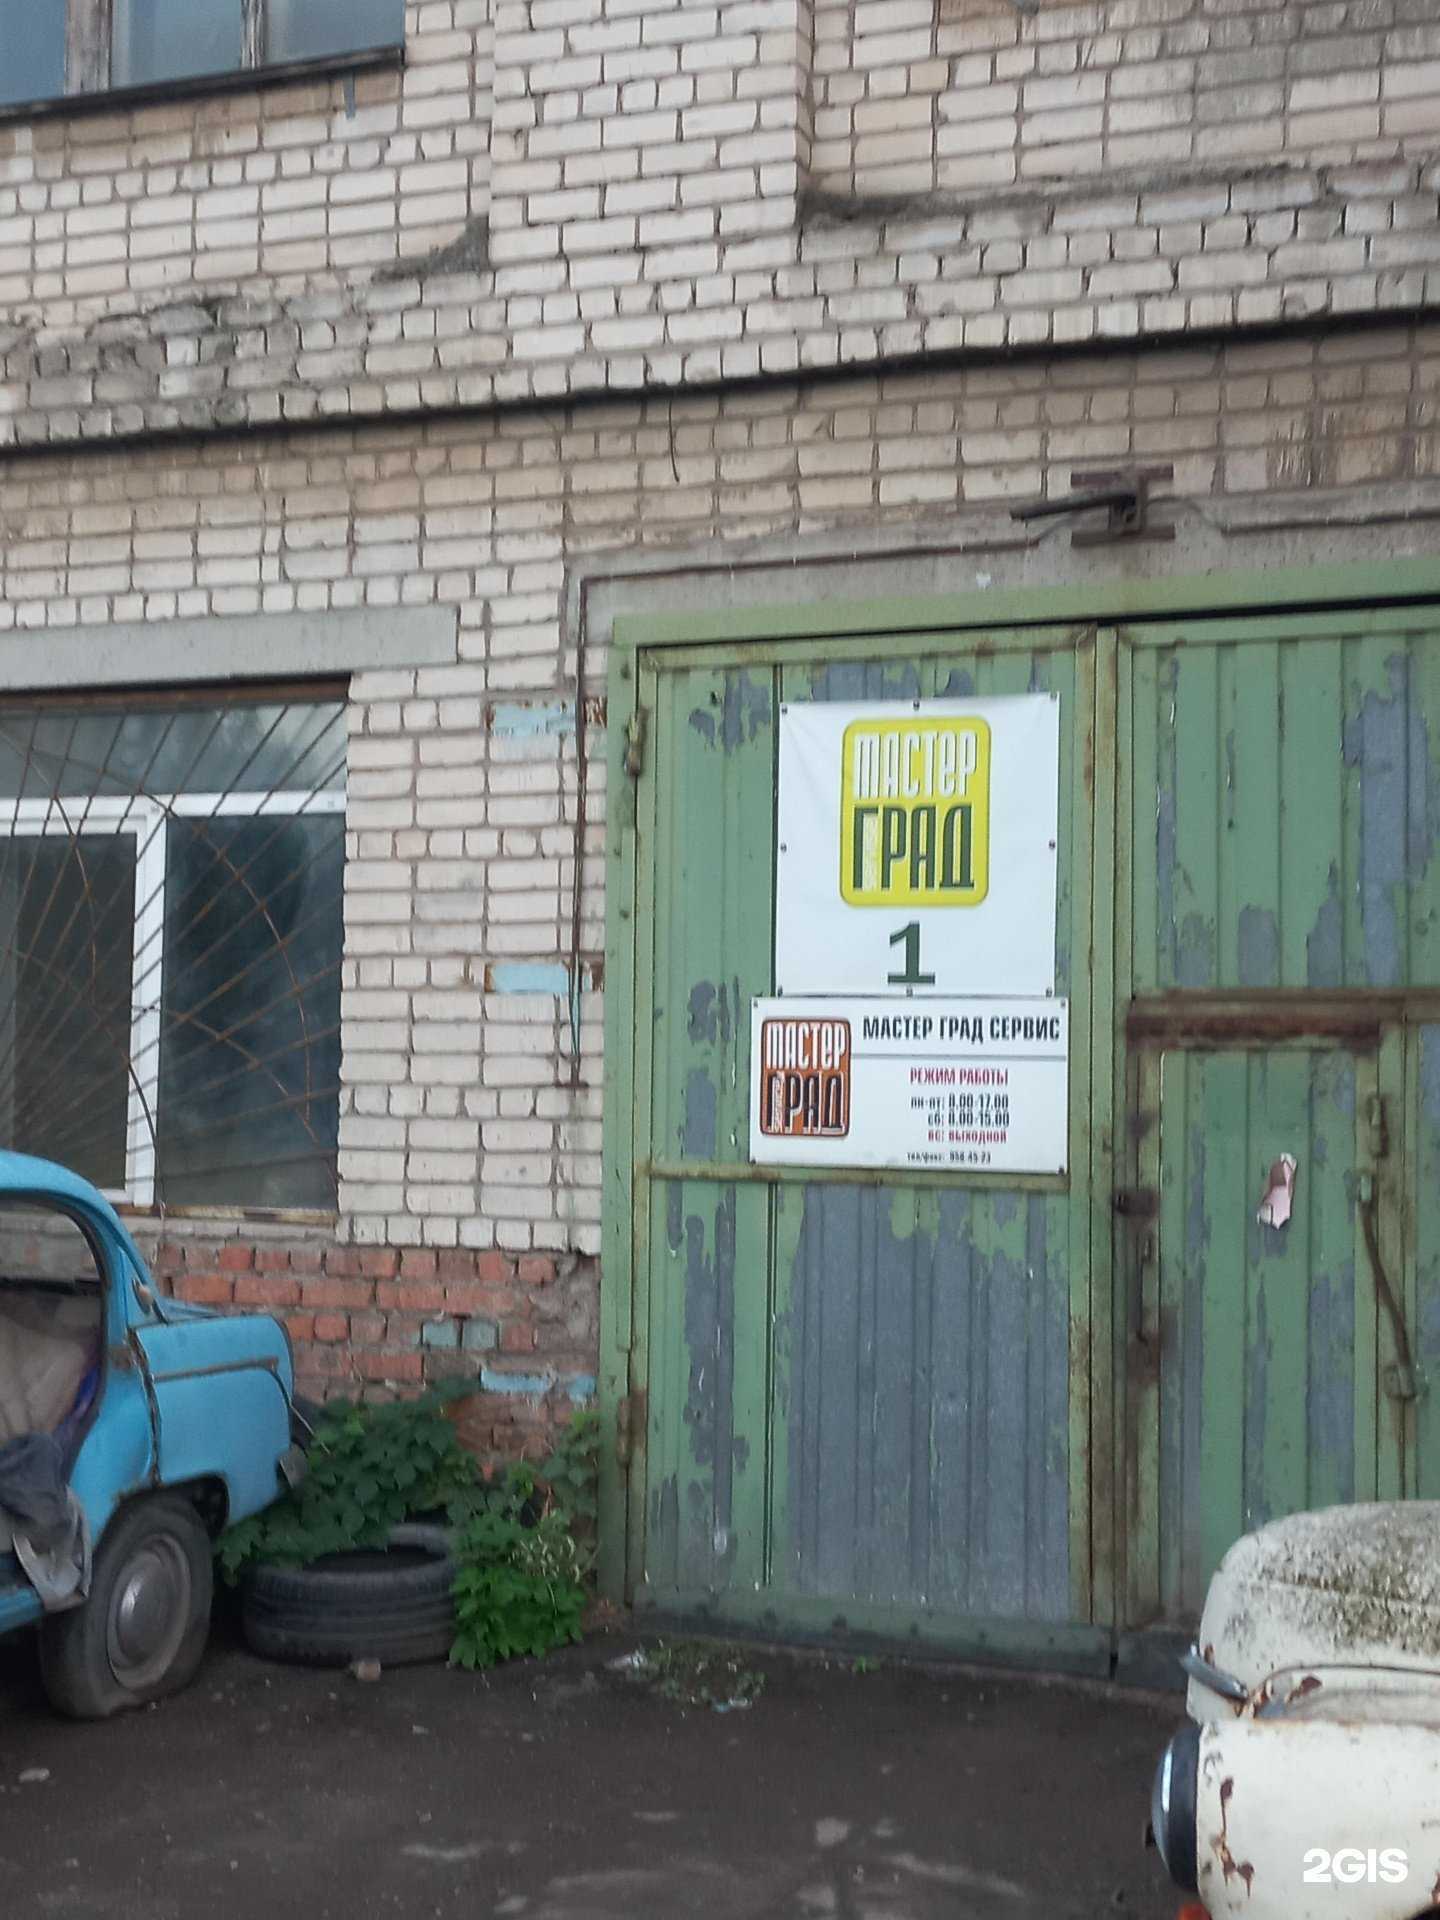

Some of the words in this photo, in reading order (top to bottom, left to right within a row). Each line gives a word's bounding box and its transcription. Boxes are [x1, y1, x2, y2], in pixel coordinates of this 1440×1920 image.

[852, 804, 975, 890] ГРАД
[887, 920, 936, 985] 1
[863, 1016, 932, 1040] МАСТЕР
[940, 1016, 983, 1045] ГРАД
[990, 1016, 1060, 1041] СЕРВИС
[766, 1071, 846, 1134] ГРАД
[910, 1067, 955, 1085] РЕЖИМ
[960, 1068, 1008, 1086] РАБОТЫ
